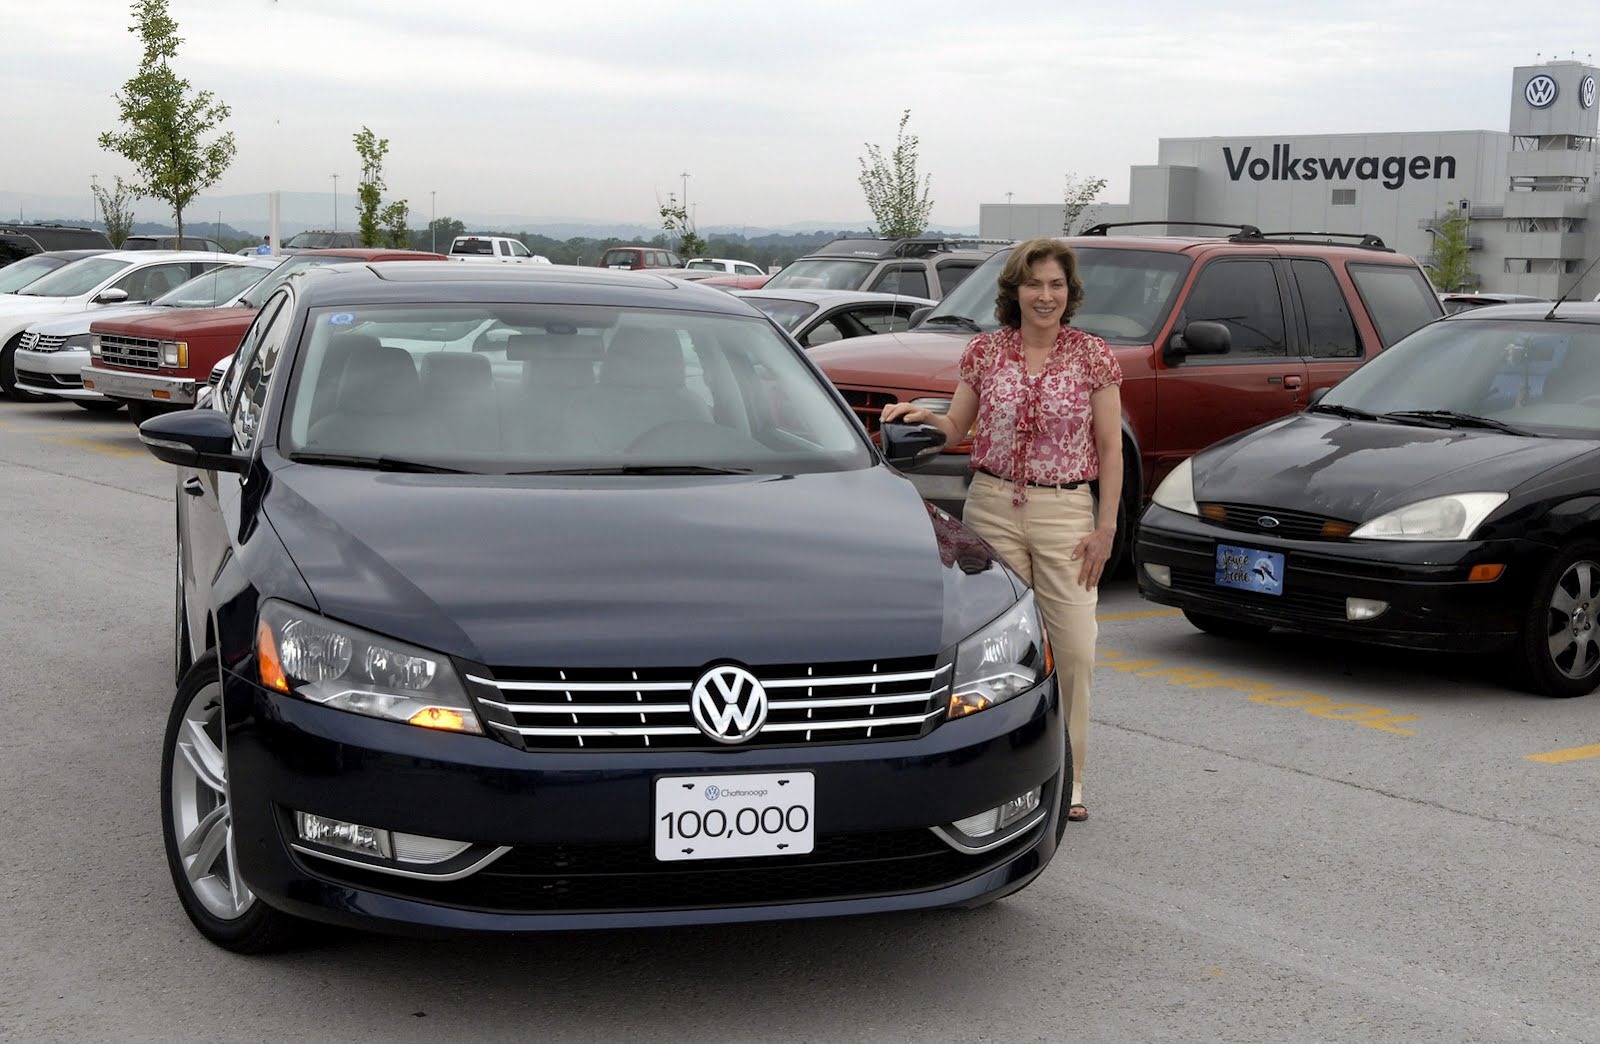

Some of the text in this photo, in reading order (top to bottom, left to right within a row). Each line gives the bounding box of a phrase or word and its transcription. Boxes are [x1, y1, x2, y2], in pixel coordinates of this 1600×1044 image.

[1525, 74, 1557, 107] VW
[1223, 144, 1456, 190] Volkswagen
[1220, 550, 1249, 569] Joyce
[692, 666, 768, 743] VW
[1095, 648, 1422, 735] ARPOOL
[721, 789, 768, 798] Chattanooga
[661, 805, 809, 839] 100,000
